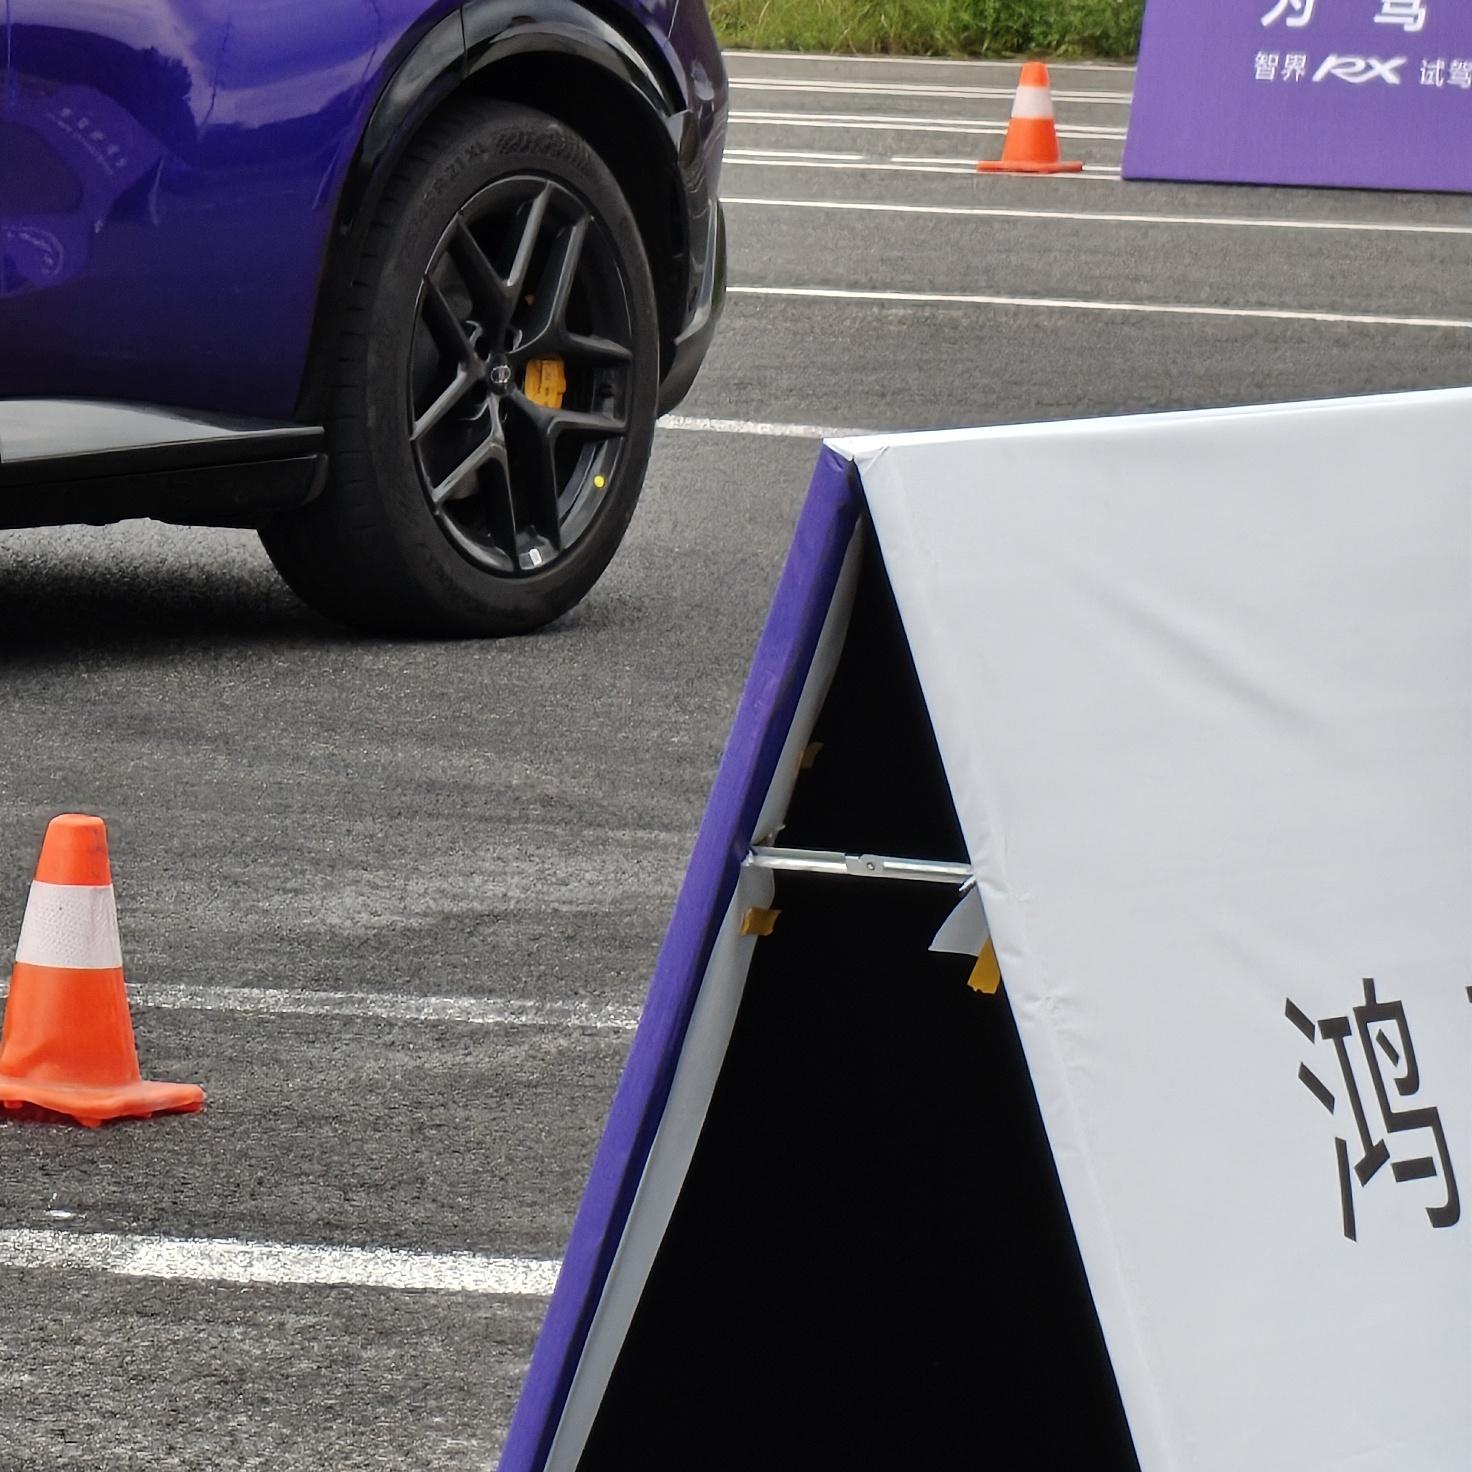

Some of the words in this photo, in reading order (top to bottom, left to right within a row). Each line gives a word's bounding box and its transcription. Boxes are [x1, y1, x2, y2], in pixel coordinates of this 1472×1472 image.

[1255, 51, 1306, 82] 智界
[1312, 54, 1406, 84] RX
[1285, 978, 1472, 1242] 鸿
